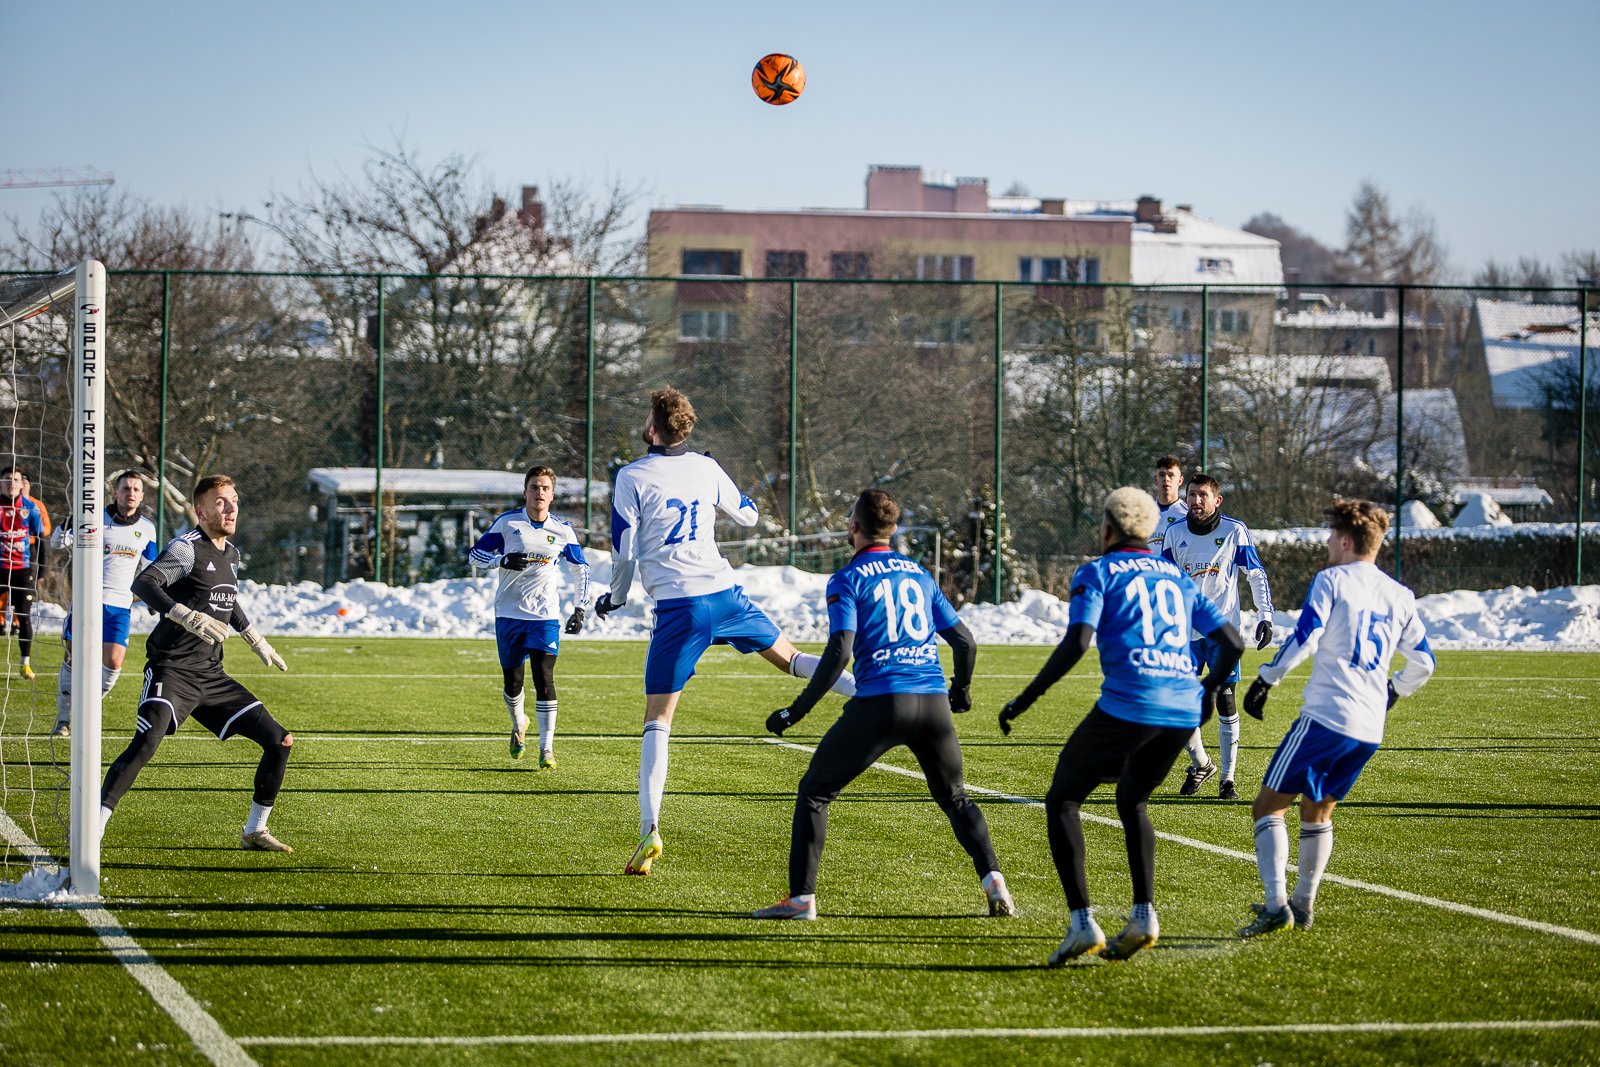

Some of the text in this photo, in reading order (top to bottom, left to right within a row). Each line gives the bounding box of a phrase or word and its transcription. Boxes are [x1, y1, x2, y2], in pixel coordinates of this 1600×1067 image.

[82, 322, 96, 515] SPORT TRANSFER
[665, 498, 700, 545] 21
[856, 559, 924, 578] WILCZEK
[873, 578, 928, 643] 18
[1125, 576, 1187, 648] 19
[1350, 609, 1393, 672] 15
[155, 682, 164, 697] 1
